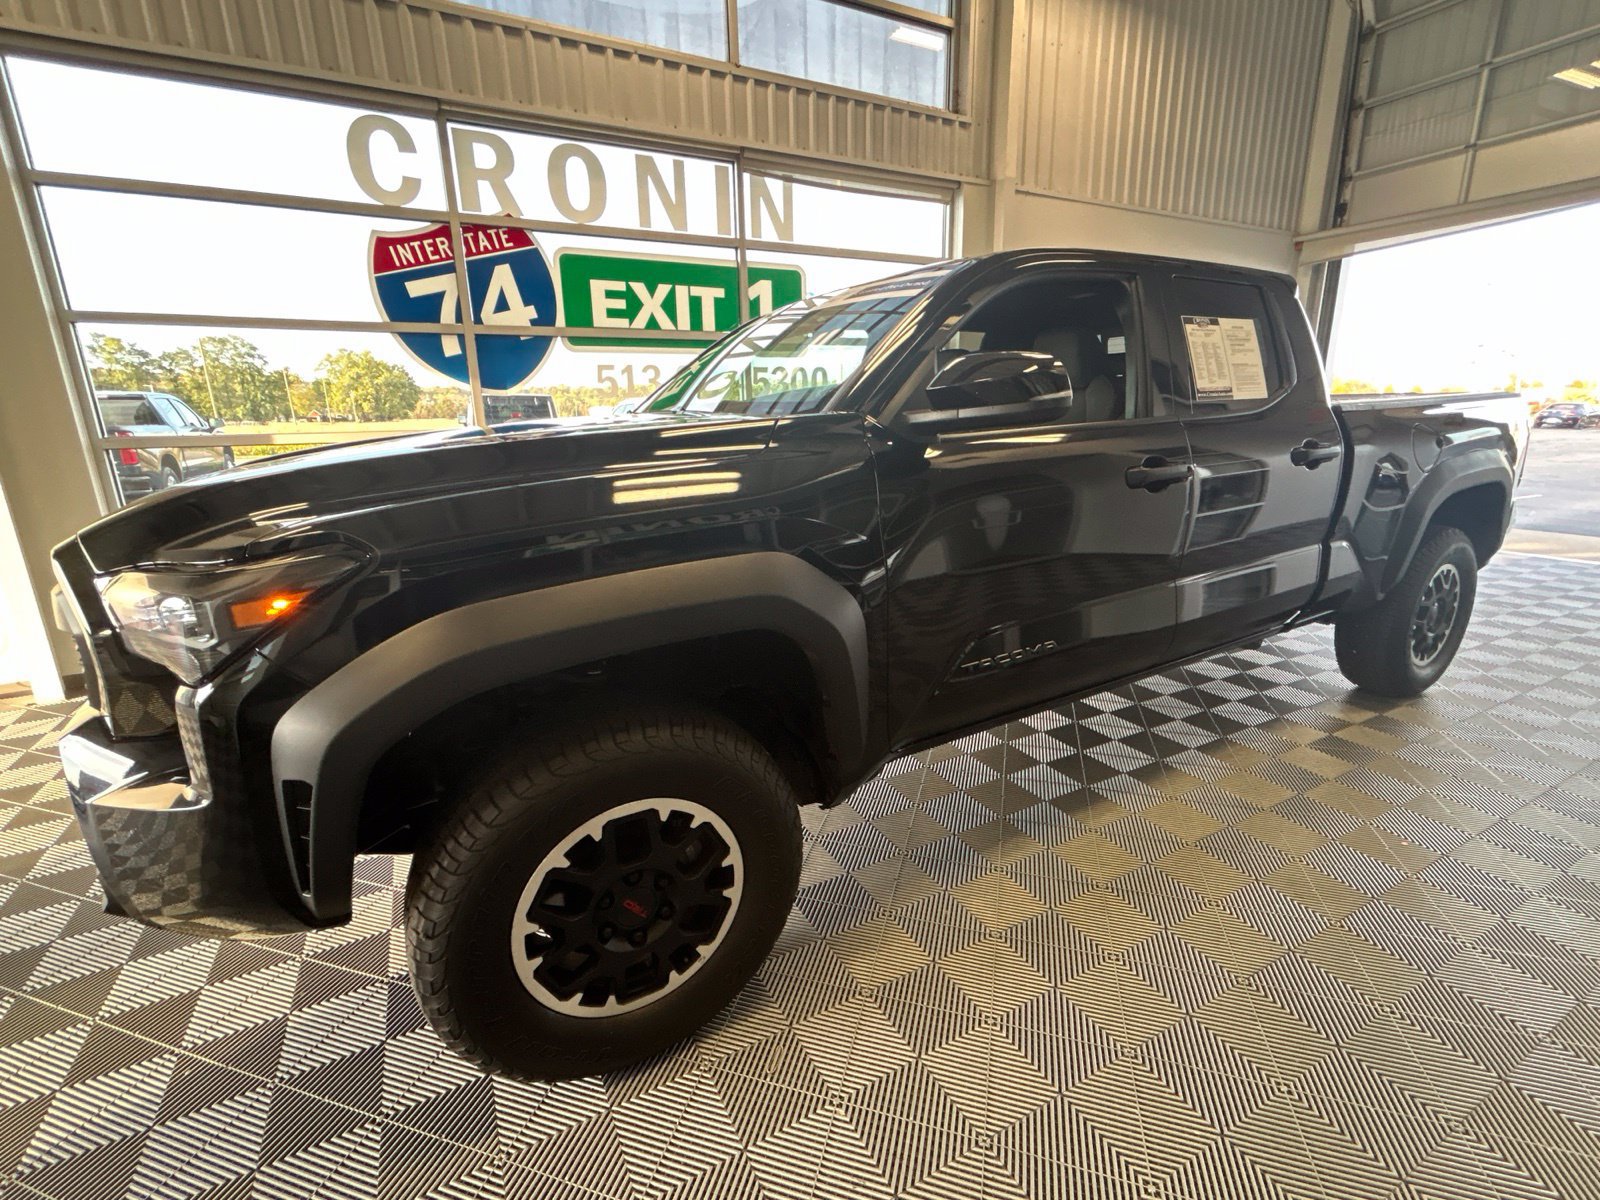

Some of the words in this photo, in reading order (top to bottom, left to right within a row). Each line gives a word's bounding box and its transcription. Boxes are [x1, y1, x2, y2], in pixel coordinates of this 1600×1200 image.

[346, 114, 793, 242] CRONIN
[388, 227, 514, 267] INTERTATE
[404, 263, 539, 358] 74
[589, 279, 726, 332] EXIT
[748, 279, 773, 318] 1
